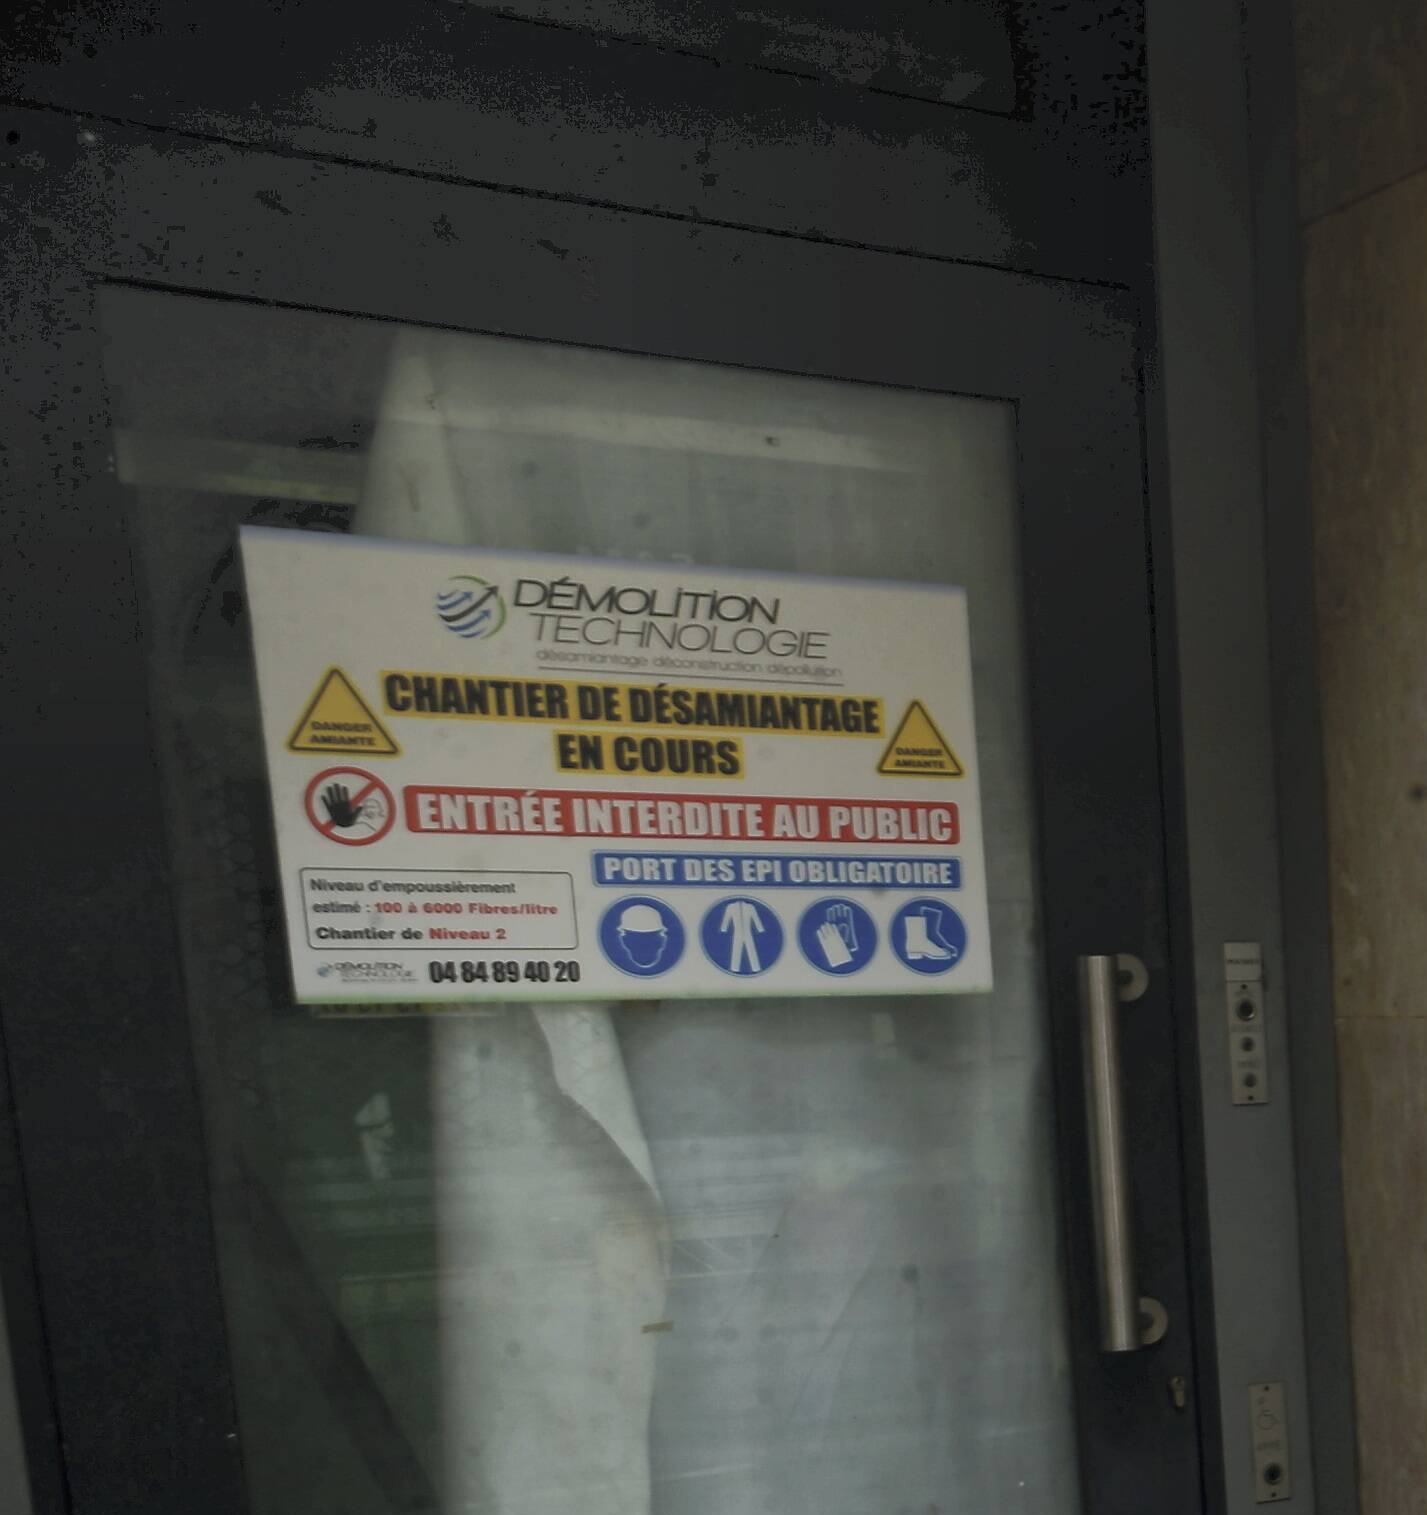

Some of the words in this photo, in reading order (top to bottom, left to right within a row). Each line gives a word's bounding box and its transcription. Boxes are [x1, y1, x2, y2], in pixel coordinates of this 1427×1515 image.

[529, 611, 831, 660] TECHNOLOGIE
[536, 647, 649, 667] désamiantage
[652, 655, 765, 673] déconstruction
[384, 673, 570, 719] CHANTIER
[578, 686, 622, 722] DE
[627, 682, 880, 734] DÉSAMIANTAGE
[558, 734, 604, 771] EN
[614, 737, 741, 775] COURS
[418, 791, 564, 833] ENTRÉE
[572, 798, 764, 838] INTERDITE
[772, 804, 819, 839] AU
[828, 805, 952, 841] PUBLIC
[603, 856, 674, 880] PORT
[684, 859, 733, 881] DES
[741, 859, 783, 882] EPI
[787, 860, 952, 885] OBLIGATOIRE
[310, 879, 364, 892] Niveau
[374, 903, 402, 913] 100
[423, 903, 462, 914] 6000
[468, 902, 558, 915] Fibres/litre
[316, 926, 395, 940] Chantier
[401, 928, 423, 940] de
[429, 928, 490, 940] Niveau
[495, 928, 507, 940] 2
[429, 961, 457, 983] 04
[461, 961, 488, 983] 84
[492, 961, 521, 983] 89
[523, 961, 550, 983] 40
[554, 961, 581, 983] 20
